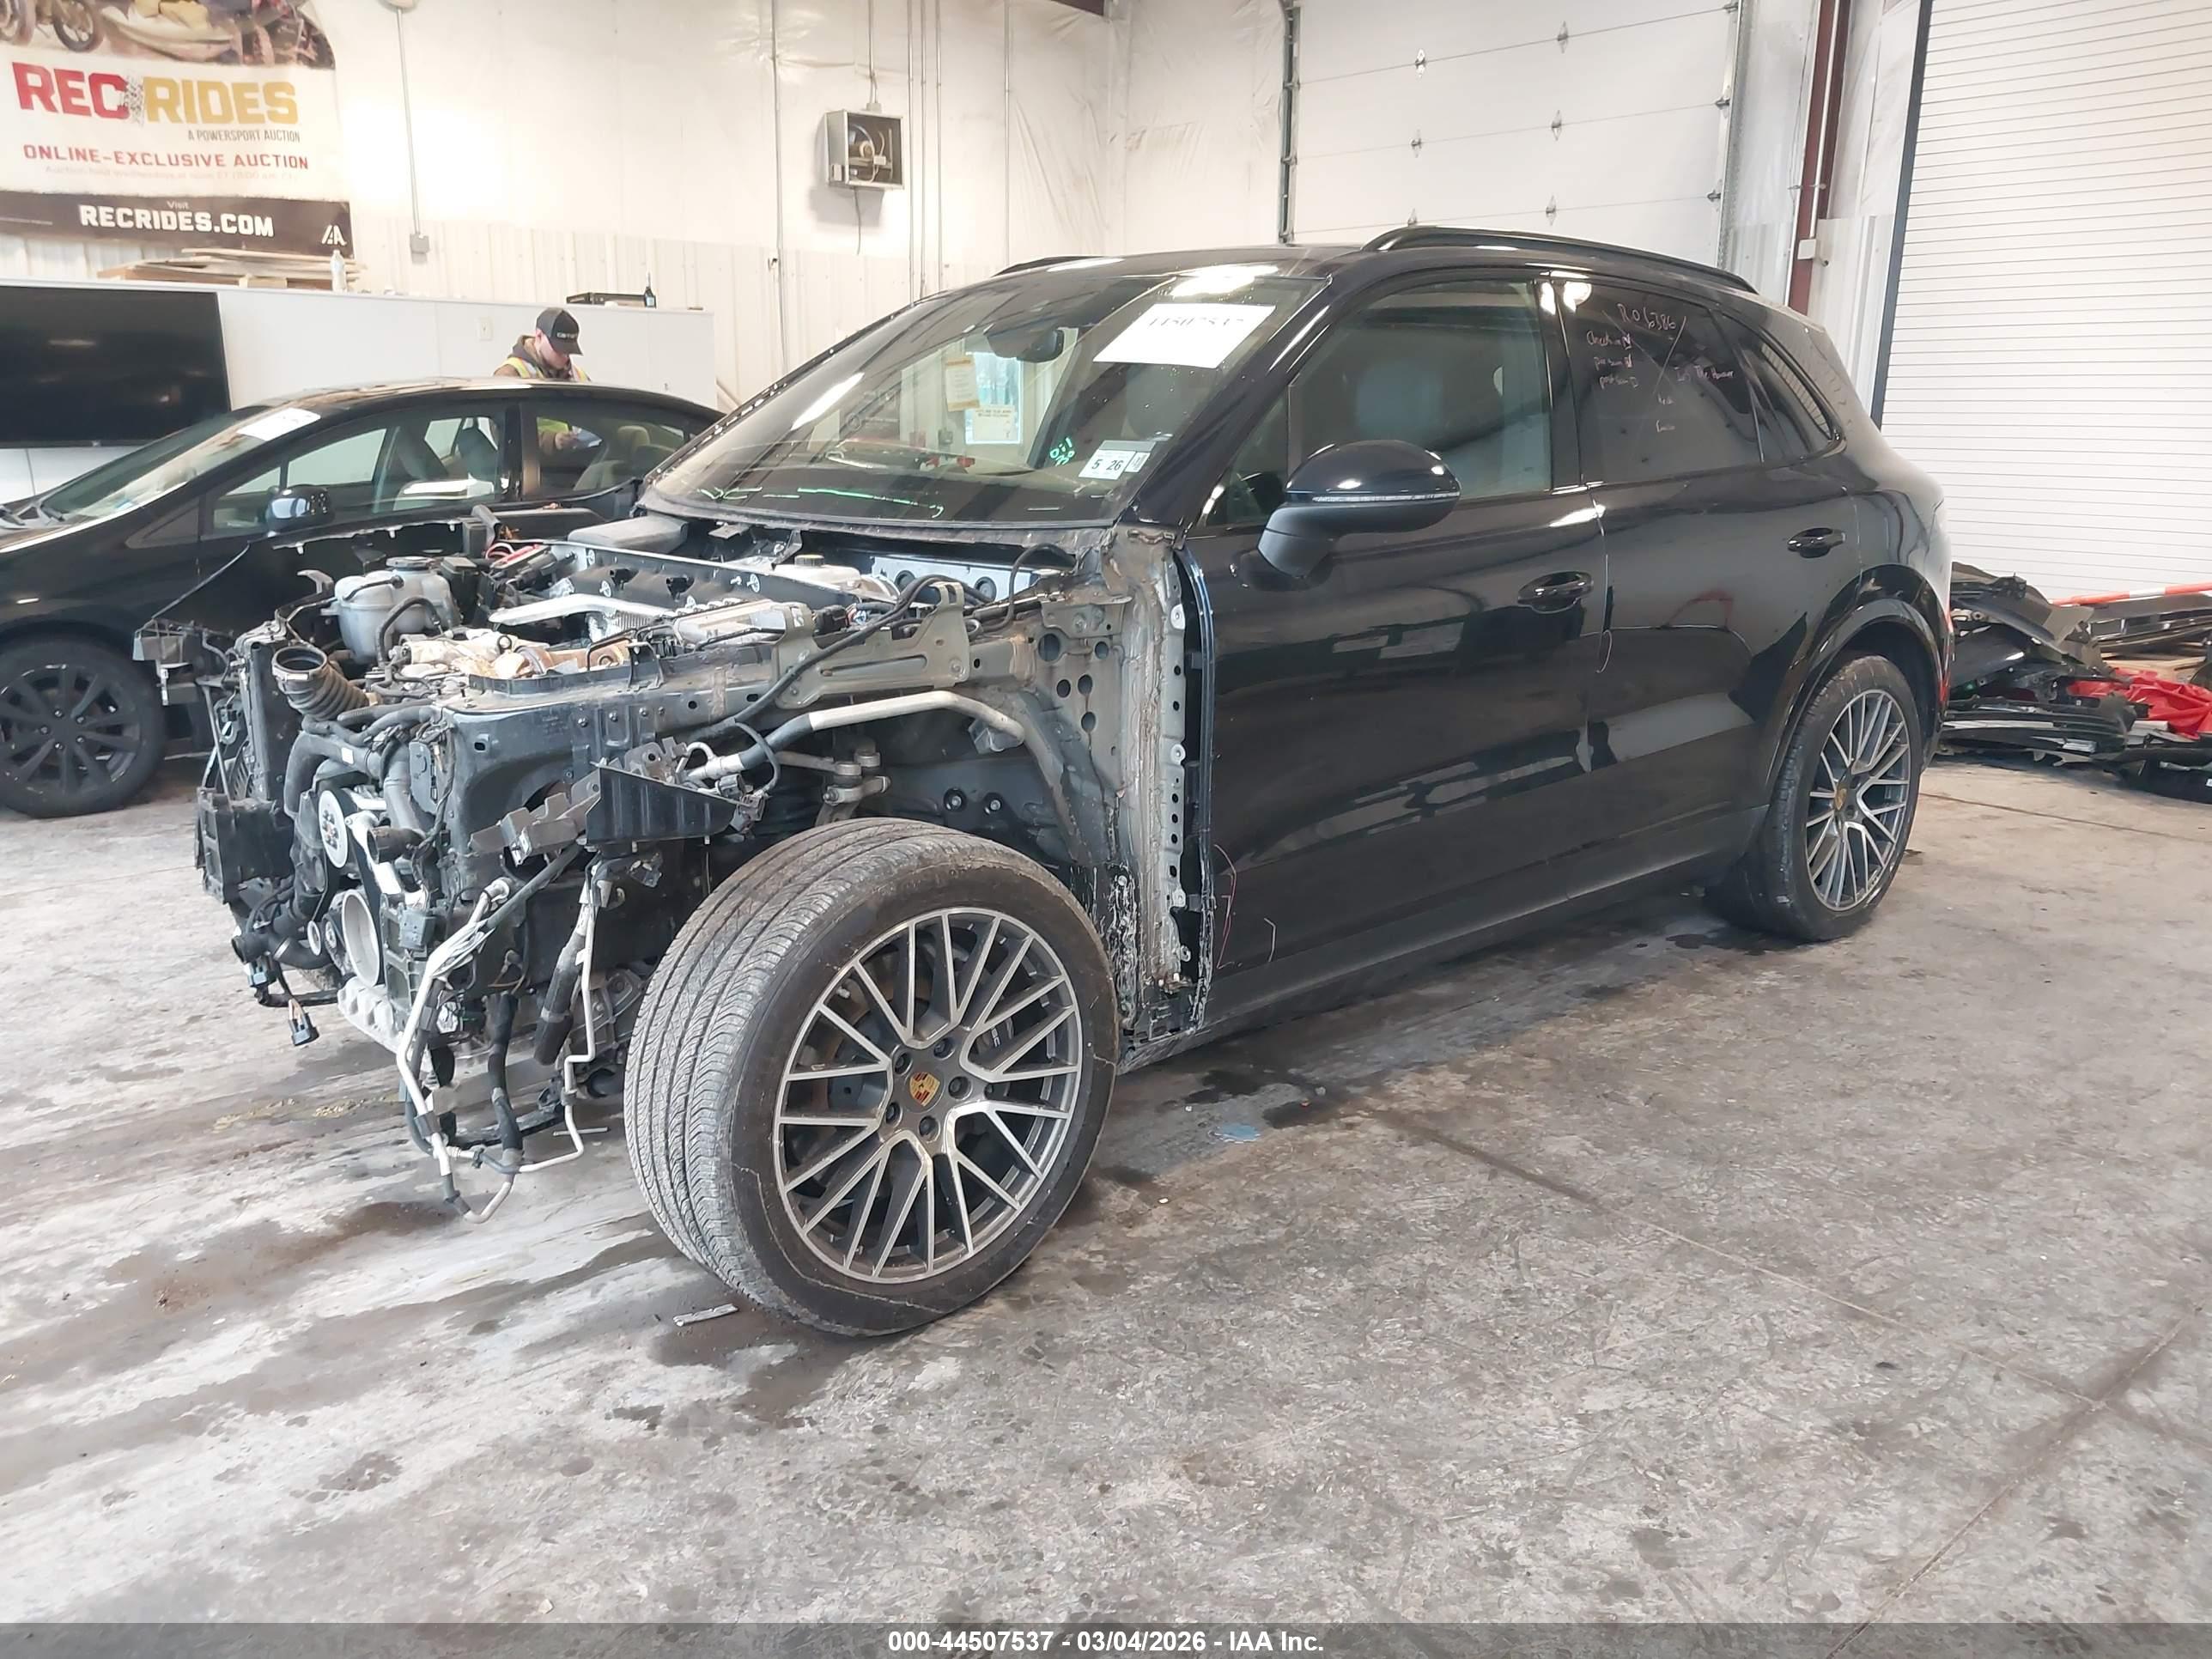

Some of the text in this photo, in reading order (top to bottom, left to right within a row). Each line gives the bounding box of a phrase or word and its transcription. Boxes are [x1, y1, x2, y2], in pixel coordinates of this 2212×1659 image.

[12, 62, 299, 125] REC RIDES
[188, 130, 301, 143] A POWERSPORT AUCTION
[23, 144, 310, 170] ONLINE-EXCLUSIVE AUCTION
[79, 204, 275, 237] RECRIDES.COM
[1091, 459, 1103, 470] 5
[1106, 459, 1124, 471] 26
